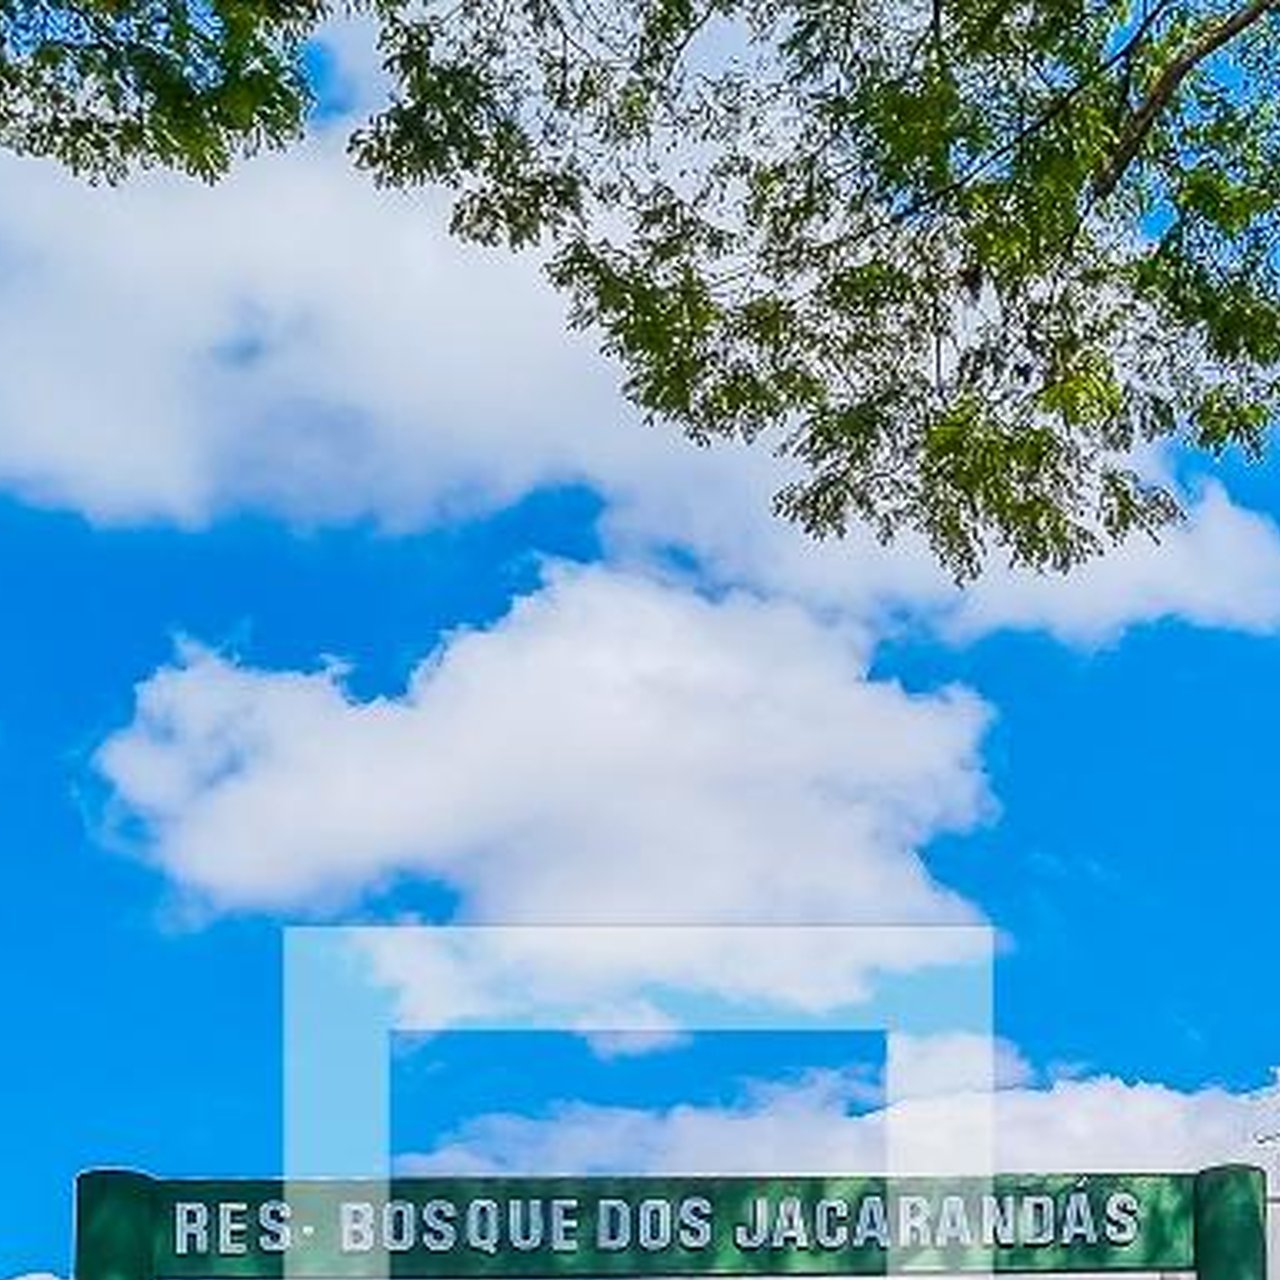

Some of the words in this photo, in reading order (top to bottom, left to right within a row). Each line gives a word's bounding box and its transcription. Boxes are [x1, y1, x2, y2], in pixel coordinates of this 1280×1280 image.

[339, 1199, 579, 1254] BOSQUE
[596, 1199, 713, 1249] DOS
[734, 1175, 1139, 1250] JACARANDÁS
